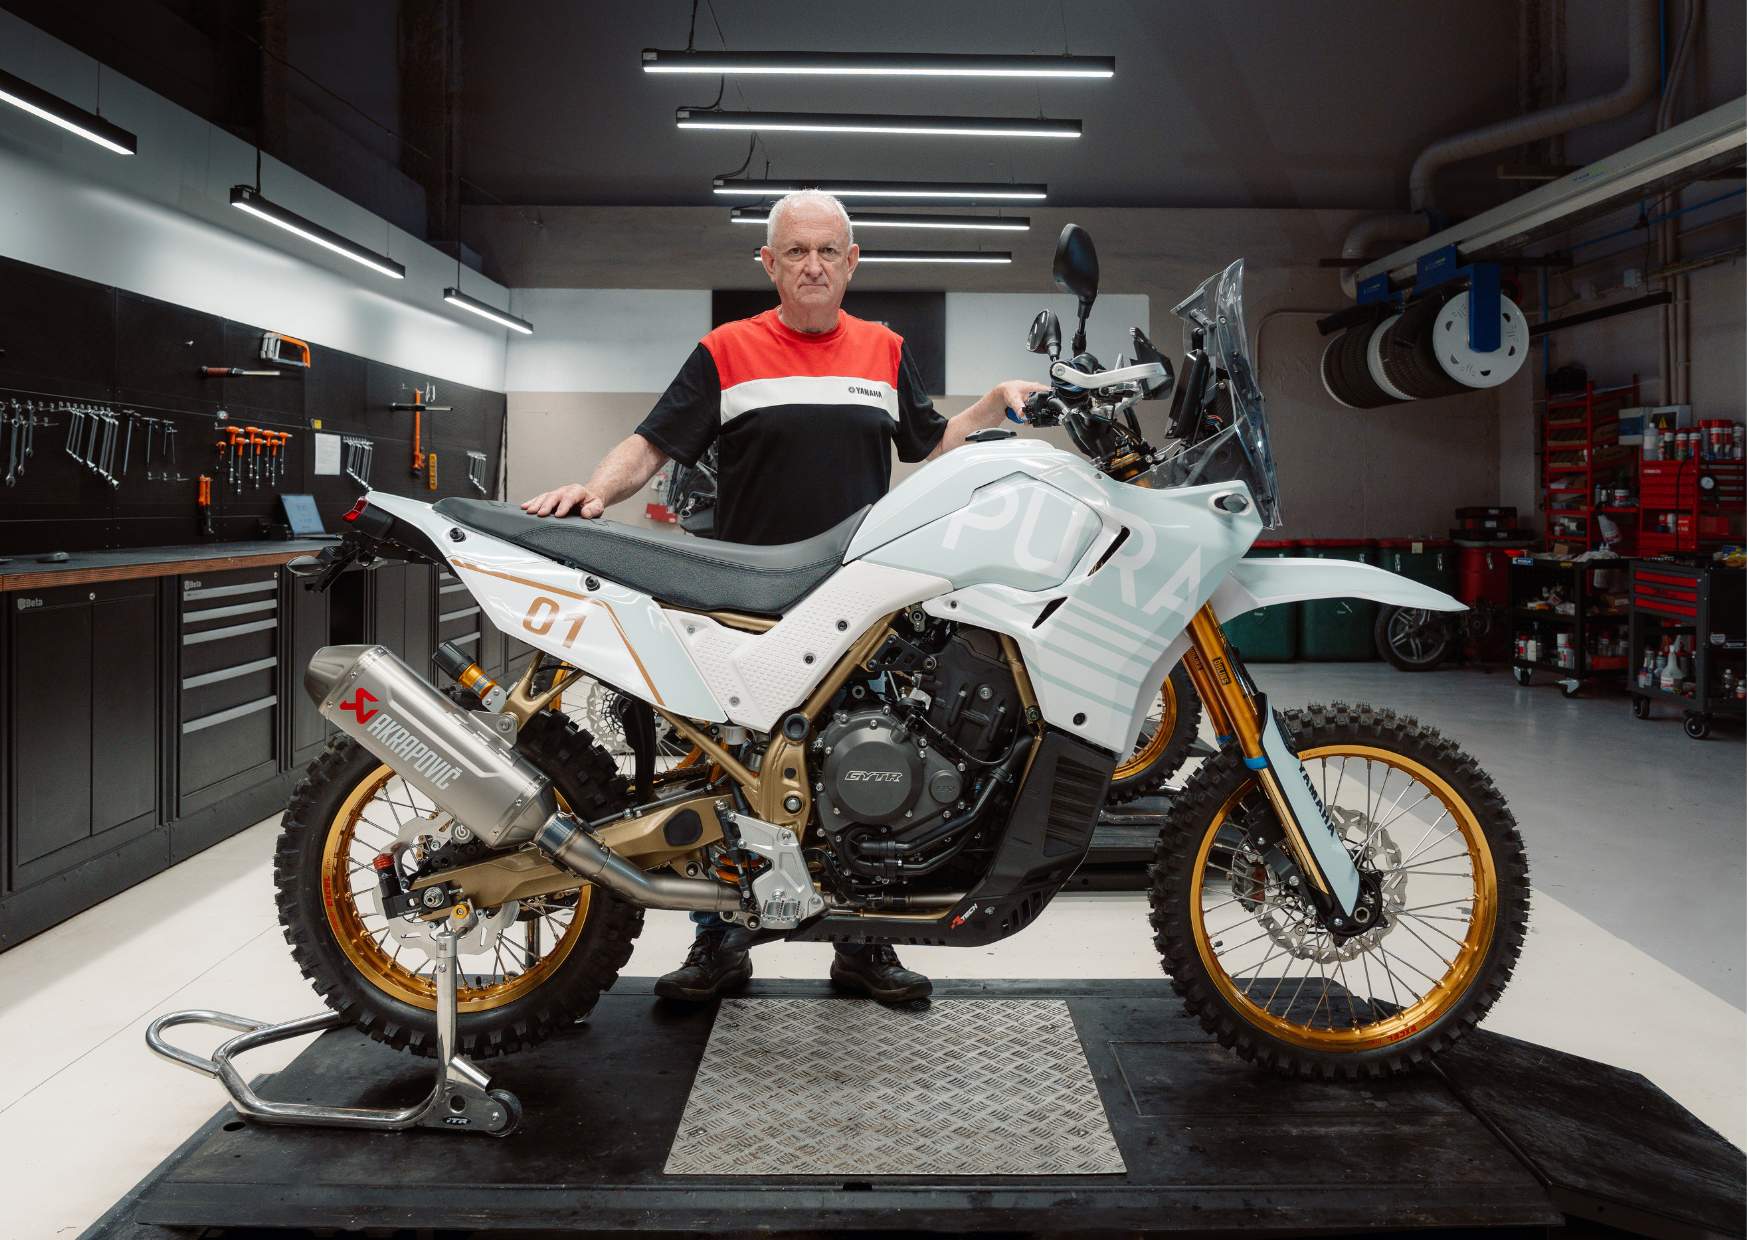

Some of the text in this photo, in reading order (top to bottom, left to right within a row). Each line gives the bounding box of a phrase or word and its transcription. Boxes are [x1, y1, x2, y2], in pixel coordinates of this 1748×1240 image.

[856, 386, 882, 399] YAMAHA
[941, 484, 1201, 627] PURA
[522, 596, 588, 648] 01
[366, 713, 463, 790] AKRAPOVIČ
[844, 770, 903, 783] GYTR
[1299, 762, 1335, 838] YAMAHA
